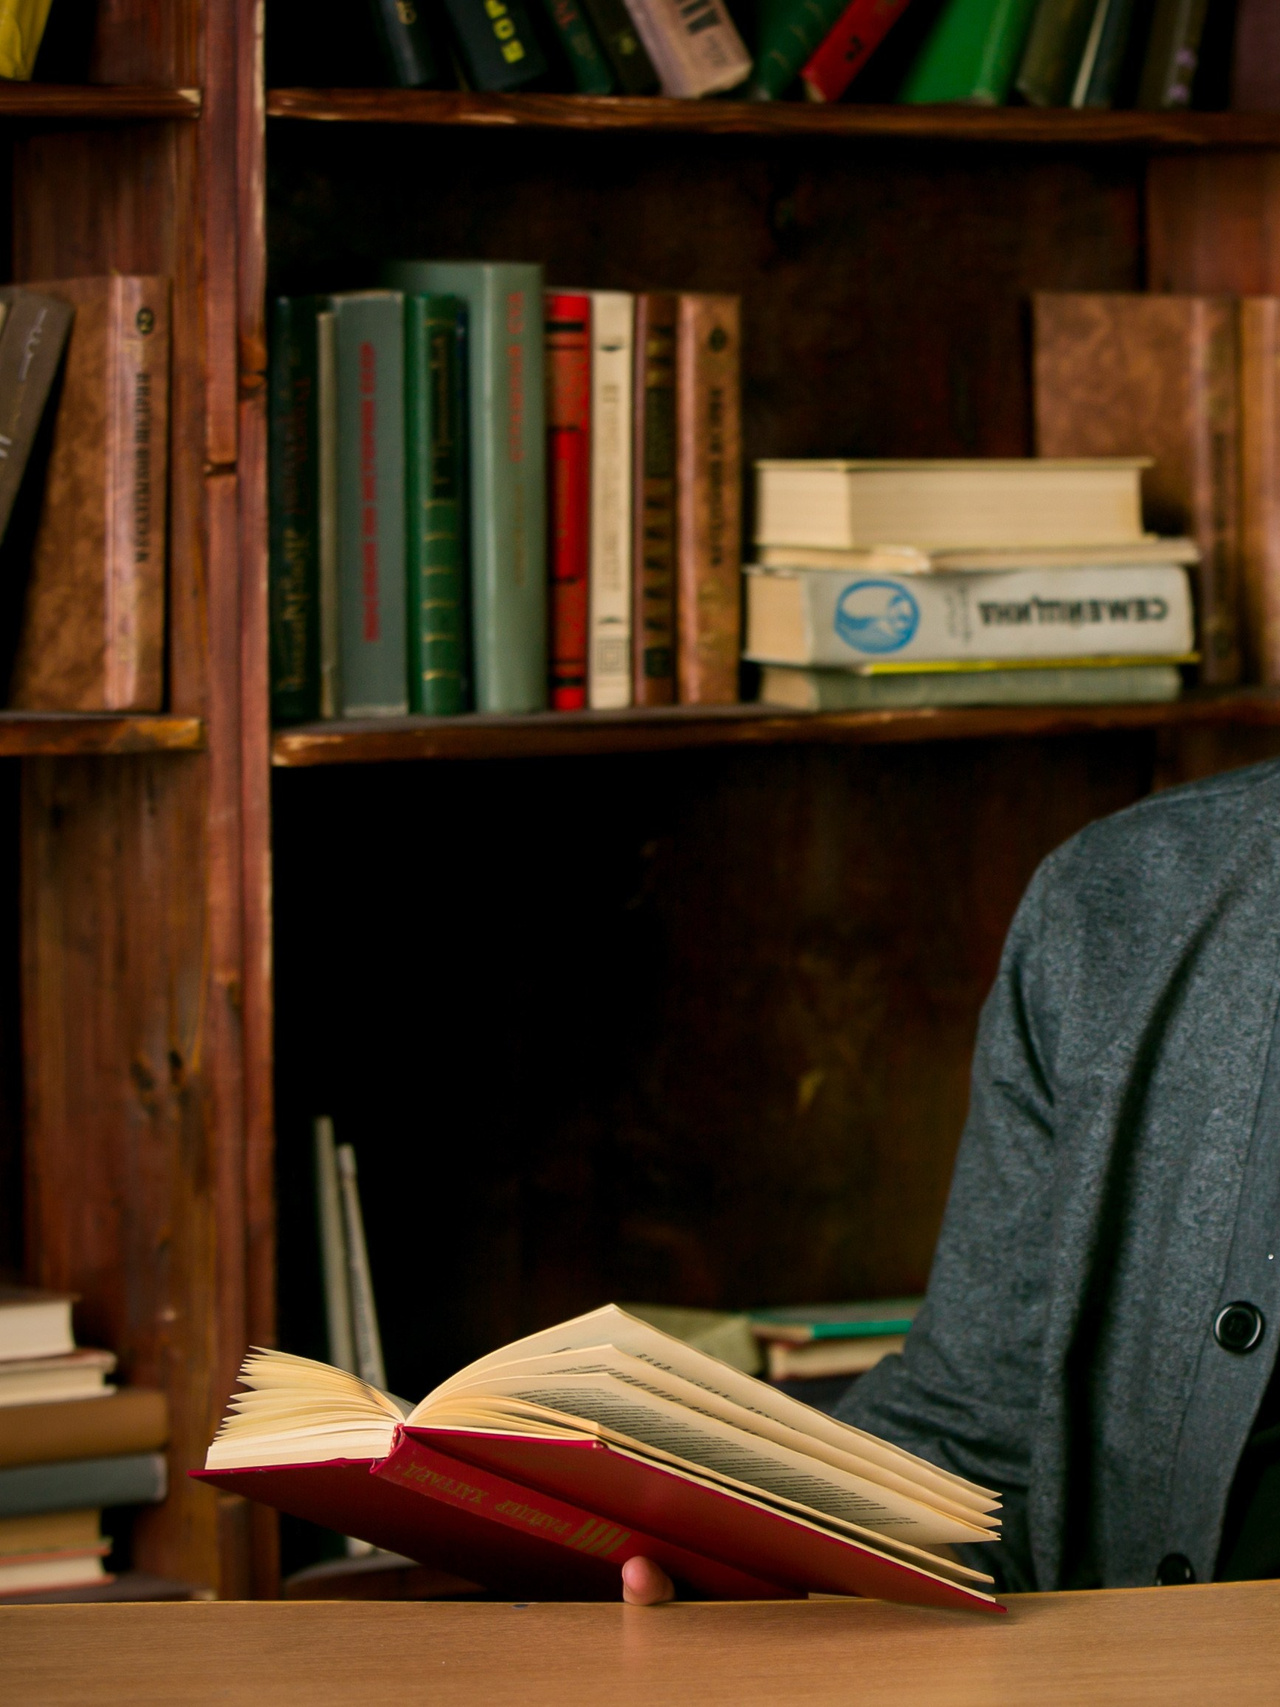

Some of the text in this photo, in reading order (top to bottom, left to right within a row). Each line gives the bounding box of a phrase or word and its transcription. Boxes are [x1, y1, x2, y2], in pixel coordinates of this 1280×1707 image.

[979, 595, 1169, 627] СЕМЕЙЩИНА
[403, 1462, 571, 1537] РАЙДЕР ХАГГАРД
